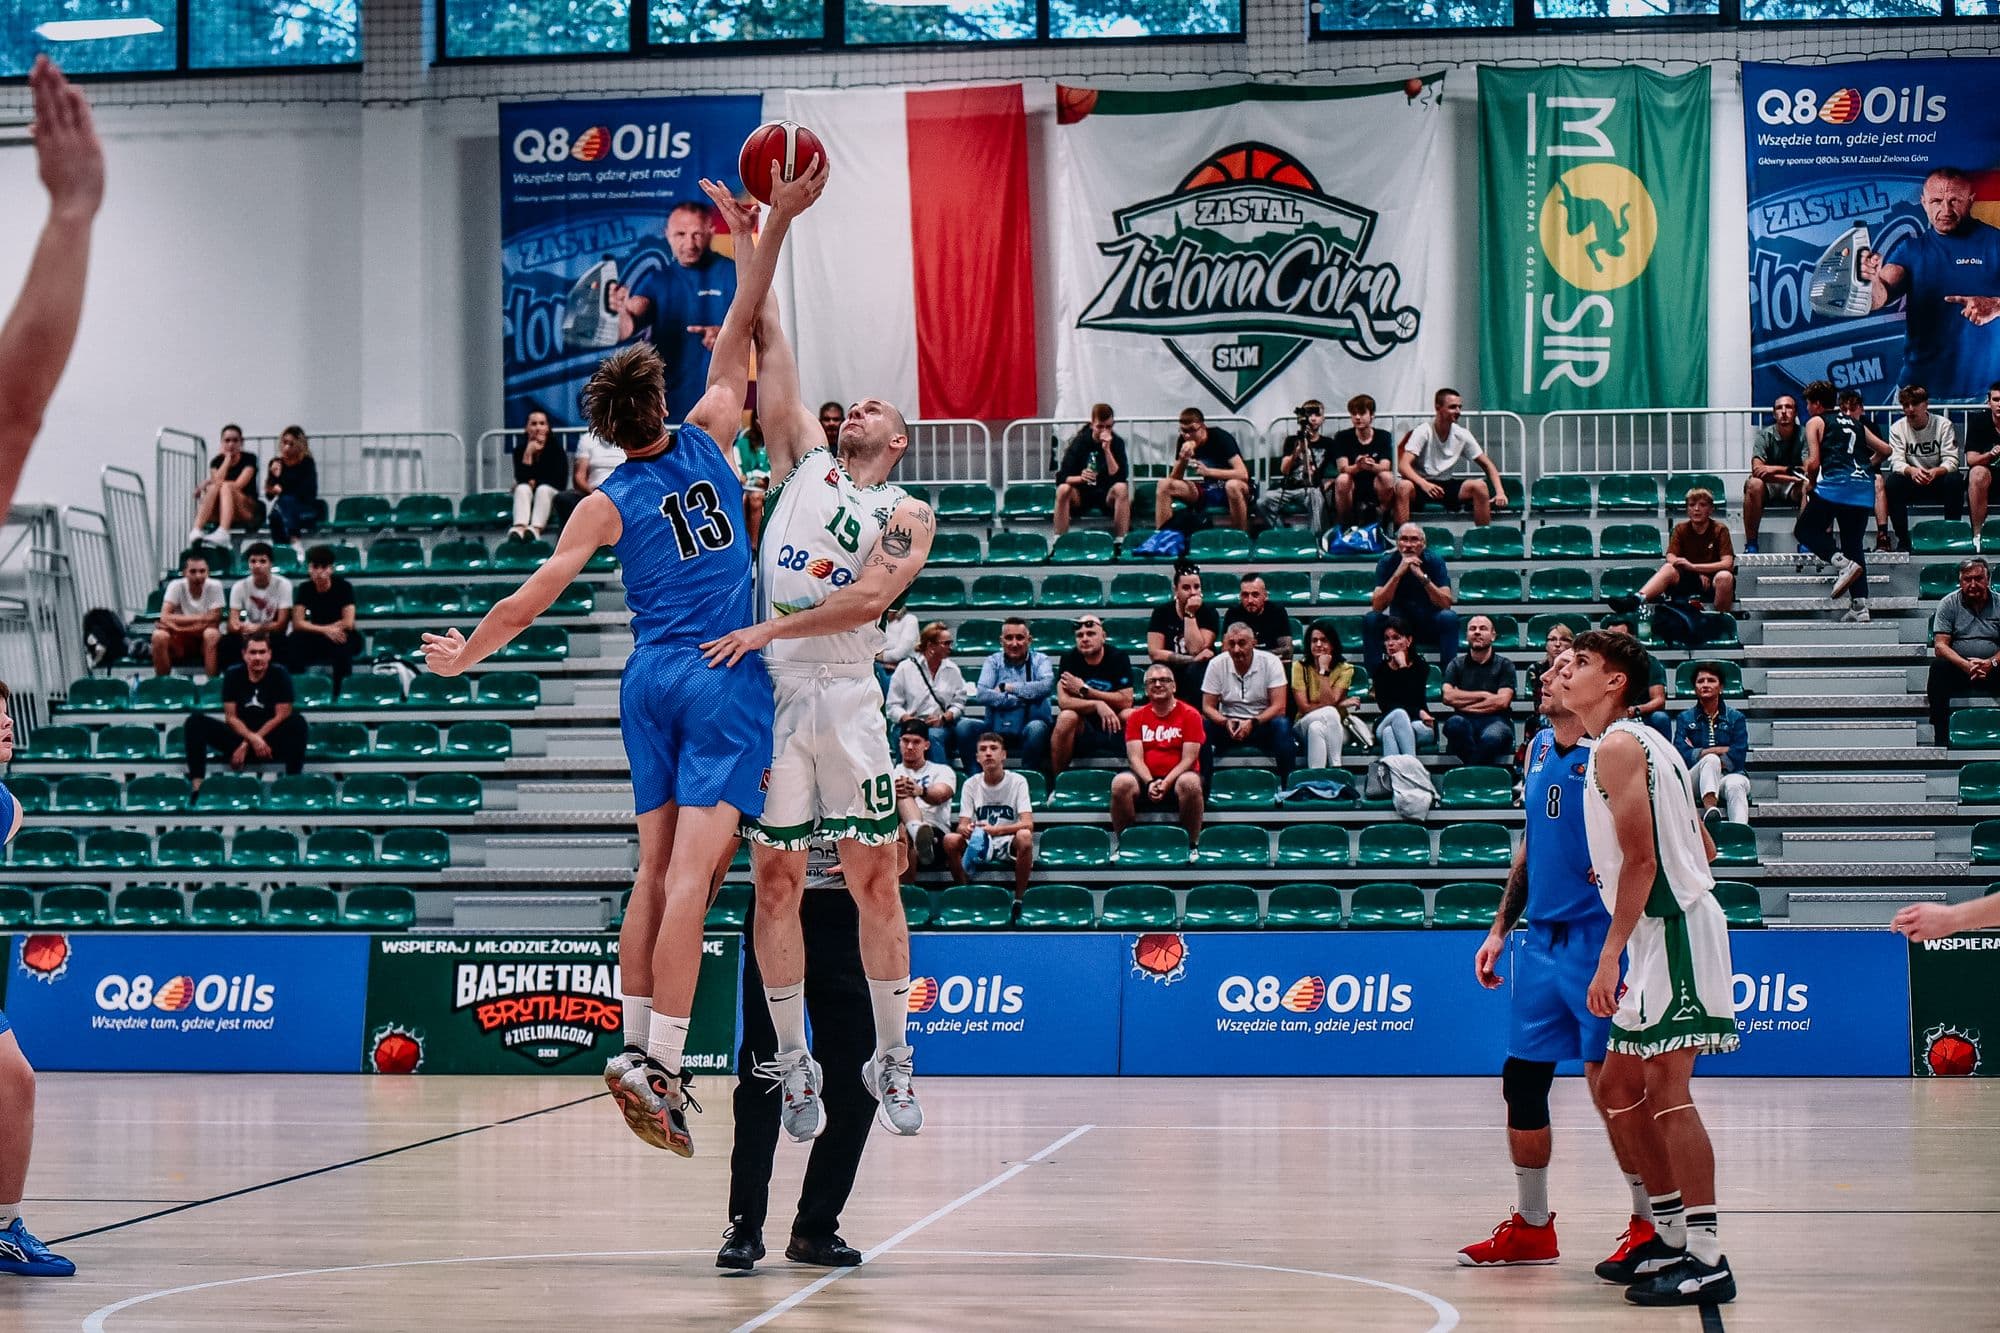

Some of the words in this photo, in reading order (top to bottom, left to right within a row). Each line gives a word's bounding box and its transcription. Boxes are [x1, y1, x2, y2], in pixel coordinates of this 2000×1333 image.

[1757, 88, 1817, 124] Q8
[1863, 86, 1947, 123] Oils
[512, 128, 570, 163] Q8
[611, 122, 691, 161] Oils
[1758, 133, 1812, 148] Wszędzie
[1815, 134, 1842, 146] tam,
[1846, 132, 1879, 147] gdzie
[1880, 132, 1903, 146] jest
[1907, 131, 1937, 143] moc!
[1196, 200, 1302, 224] ZASTAL
[1527, 162, 1536, 232] ZIELONA
[1766, 185, 1887, 231] ZASTAL
[519, 216, 634, 267] ZASTAL
[1078, 232, 1267, 326] Zielona
[1215, 345, 1260, 368] SKM
[1831, 358, 1884, 387] SKM
[1842, 427, 1856, 455] 7
[660, 480, 733, 561] 13
[825, 506, 861, 553] 19
[777, 545, 808, 571] Q8
[861, 773, 893, 813] 19
[1547, 784, 1561, 819] 8
[382, 941, 470, 954] WSPIERAJ
[475, 938, 602, 956] MŁODZIEŻOWĄ
[1923, 937, 2000, 951] WSPIERA
[95, 974, 154, 1012] Q8
[195, 974, 275, 1012] Oils
[456, 964, 622, 1008] BASKETBAL
[939, 975, 1024, 1013] Oils
[1217, 975, 1280, 1013] Q8
[1327, 974, 1413, 1013] Oils
[1731, 973, 1809, 1012] Oils
[92, 1016, 148, 1032] Wszędzie
[151, 1017, 179, 1031] tam,
[182, 1016, 215, 1032] gdzie
[216, 1016, 241, 1032] jest
[243, 1016, 275, 1031] moc!
[477, 995, 622, 1031] BROTHERS
[906, 1020, 923, 1033] m,
[927, 1019, 961, 1034] gdzie
[962, 1018, 989, 1034] jest
[992, 1019, 1024, 1032] moc!
[1217, 1019, 1277, 1035] Wszędzie
[1280, 1019, 1312, 1033] tam,
[1314, 1018, 1350, 1034] gdzie
[1351, 1018, 1378, 1034] jest
[1381, 1018, 1414, 1032] moc!
[1747, 1018, 1776, 1034] jest
[1777, 1018, 1810, 1032] moc!
[505, 1024, 593, 1046] #ZIELONAGORA
[538, 1048, 558, 1058] SKM
[681, 1054, 728, 1070] zastal.pl
